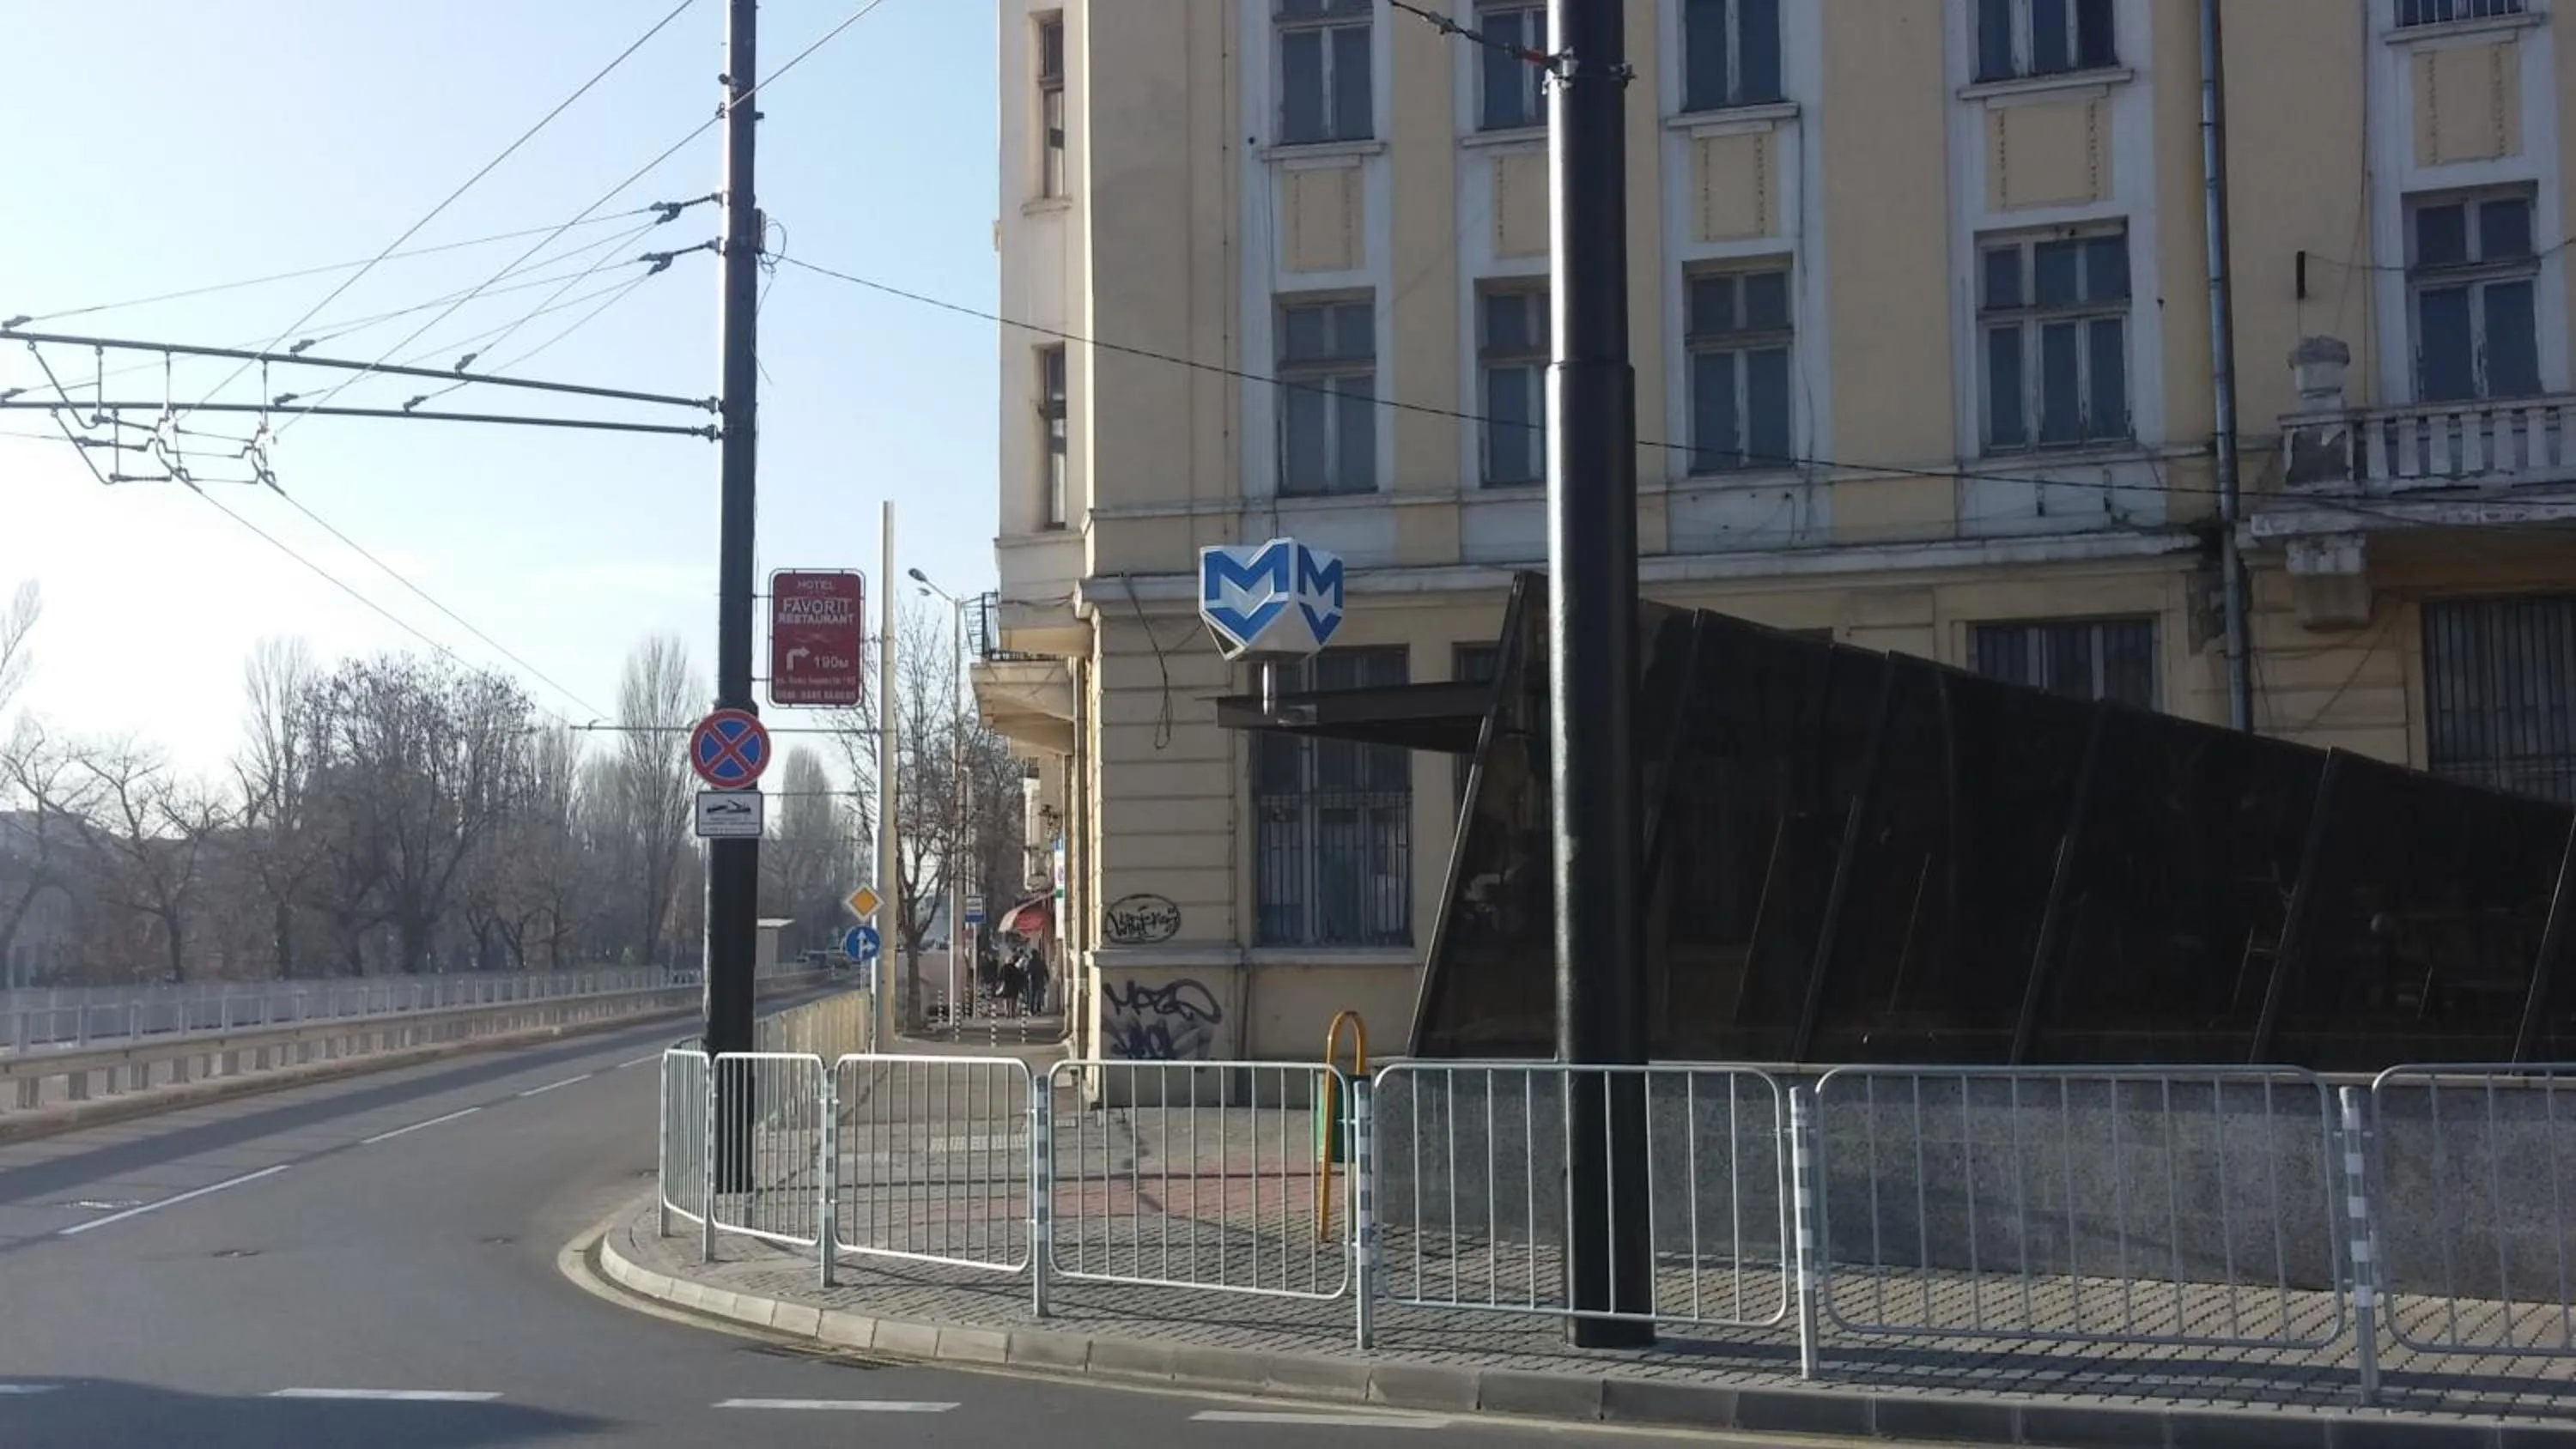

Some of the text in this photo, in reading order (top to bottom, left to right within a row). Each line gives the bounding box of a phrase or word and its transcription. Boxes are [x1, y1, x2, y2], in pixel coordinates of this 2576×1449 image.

[797, 579, 835, 591] HOTEL
[782, 597, 853, 615] FAVORIT
[778, 613, 854, 625] RESTAURANT
